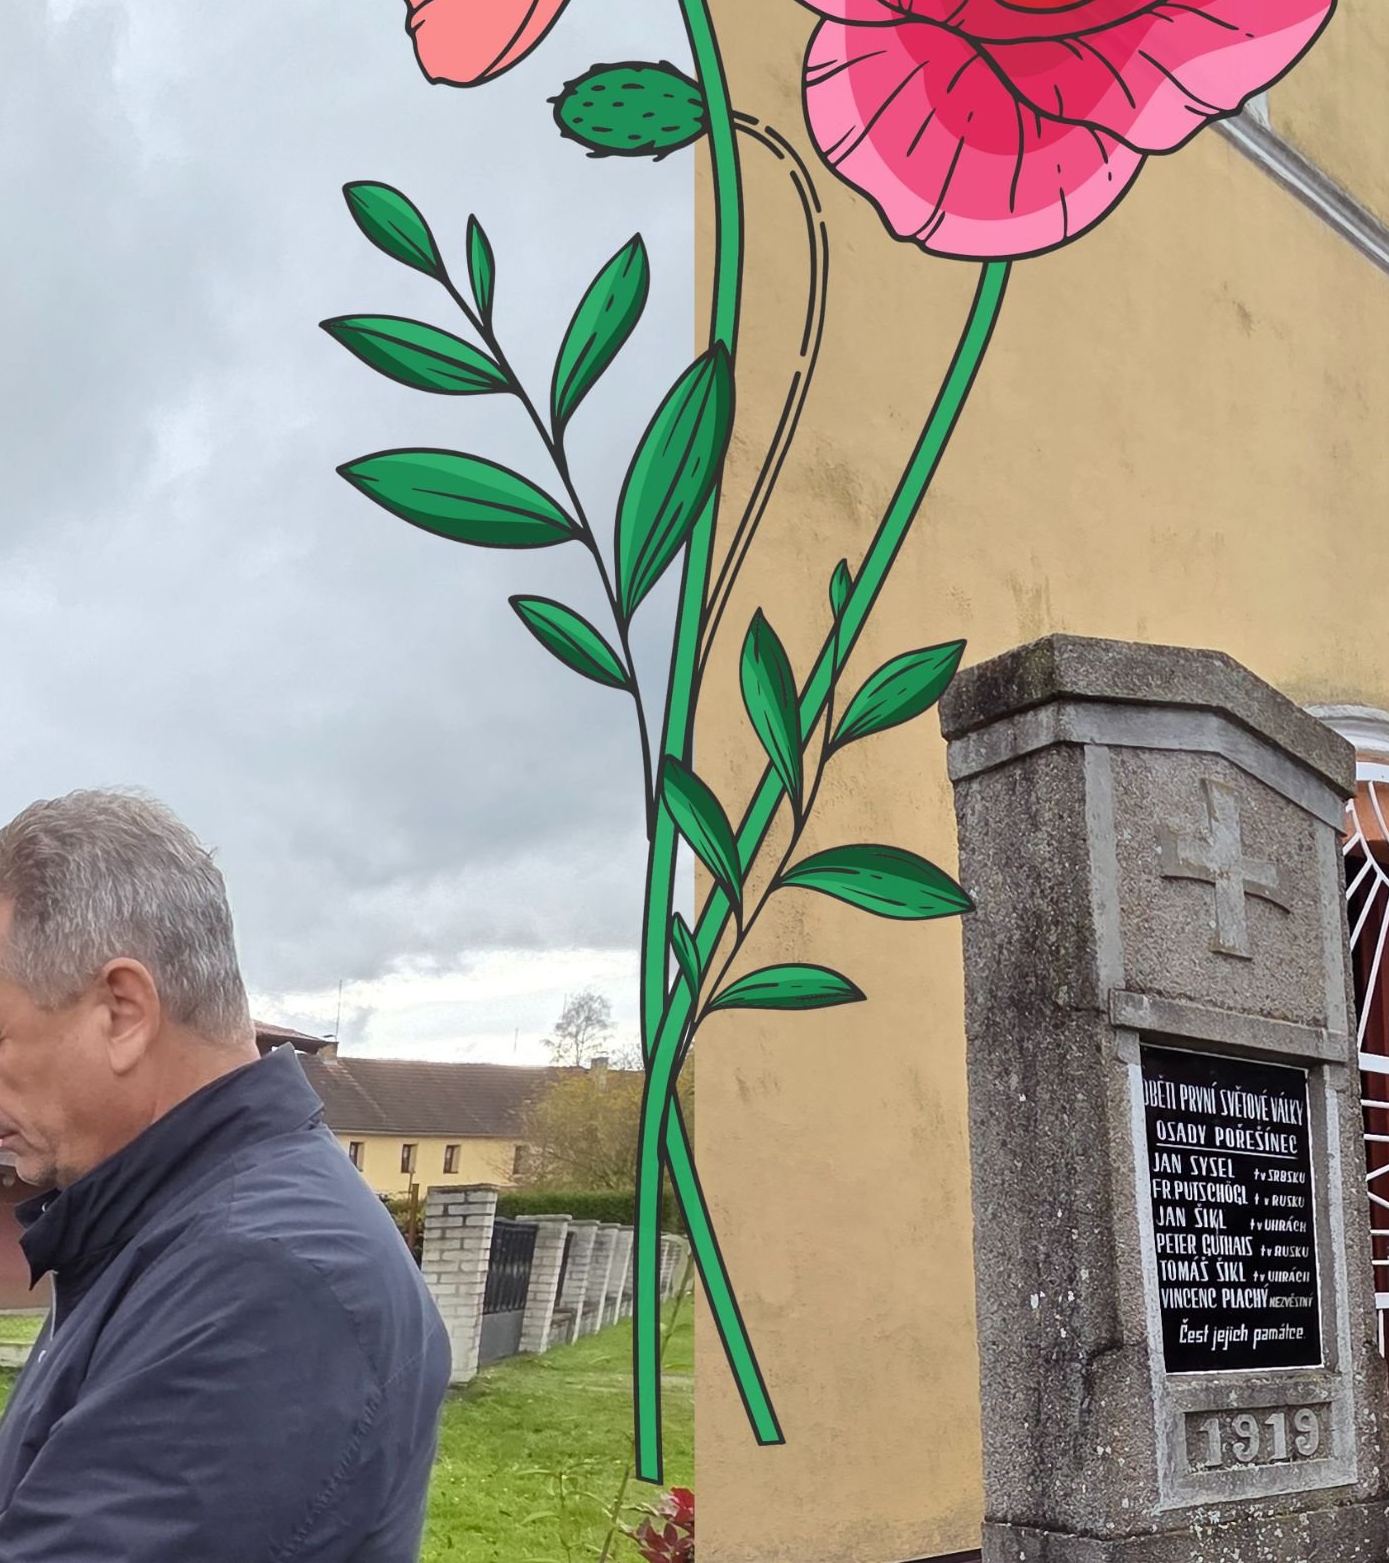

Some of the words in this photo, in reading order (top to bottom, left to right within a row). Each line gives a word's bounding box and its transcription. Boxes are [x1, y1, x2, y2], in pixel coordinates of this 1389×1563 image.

[1179, 1081, 1217, 1114] PRVNÍ
[1220, 1085, 1269, 1121] SVĚTOVÉ
[1271, 1092, 1303, 1126] VÁLKY
[1156, 1120, 1206, 1145] OSADY
[1215, 1124, 1298, 1154] POŘEŠÍNEC
[1153, 1152, 1182, 1173] JAN
[1190, 1155, 1235, 1178] SYSEL
[1268, 1169, 1305, 1184] SRBSKU
[1272, 1195, 1305, 1208] RUSKU
[1156, 1206, 1186, 1227] JAN
[1195, 1203, 1227, 1229] ŠIKL
[1264, 1216, 1306, 1233] UHRÁCH
[1156, 1233, 1197, 1254] PETER
[1274, 1245, 1309, 1257] RUSKU
[1160, 1256, 1209, 1282] TOMÁŠ
[1216, 1257, 1246, 1282] ŠIKL
[1267, 1267, 1310, 1283] UHRÁCH
[1161, 1288, 1217, 1309] VINCENC
[1222, 1283, 1269, 1309] PLACHÝ
[1269, 1292, 1314, 1308] NEZVĚSTNÝ
[1179, 1318, 1209, 1343] Čest
[1211, 1324, 1248, 1351] jejich
[1253, 1324, 1306, 1350] památce.
[1198, 1407, 1319, 1467] 1919
